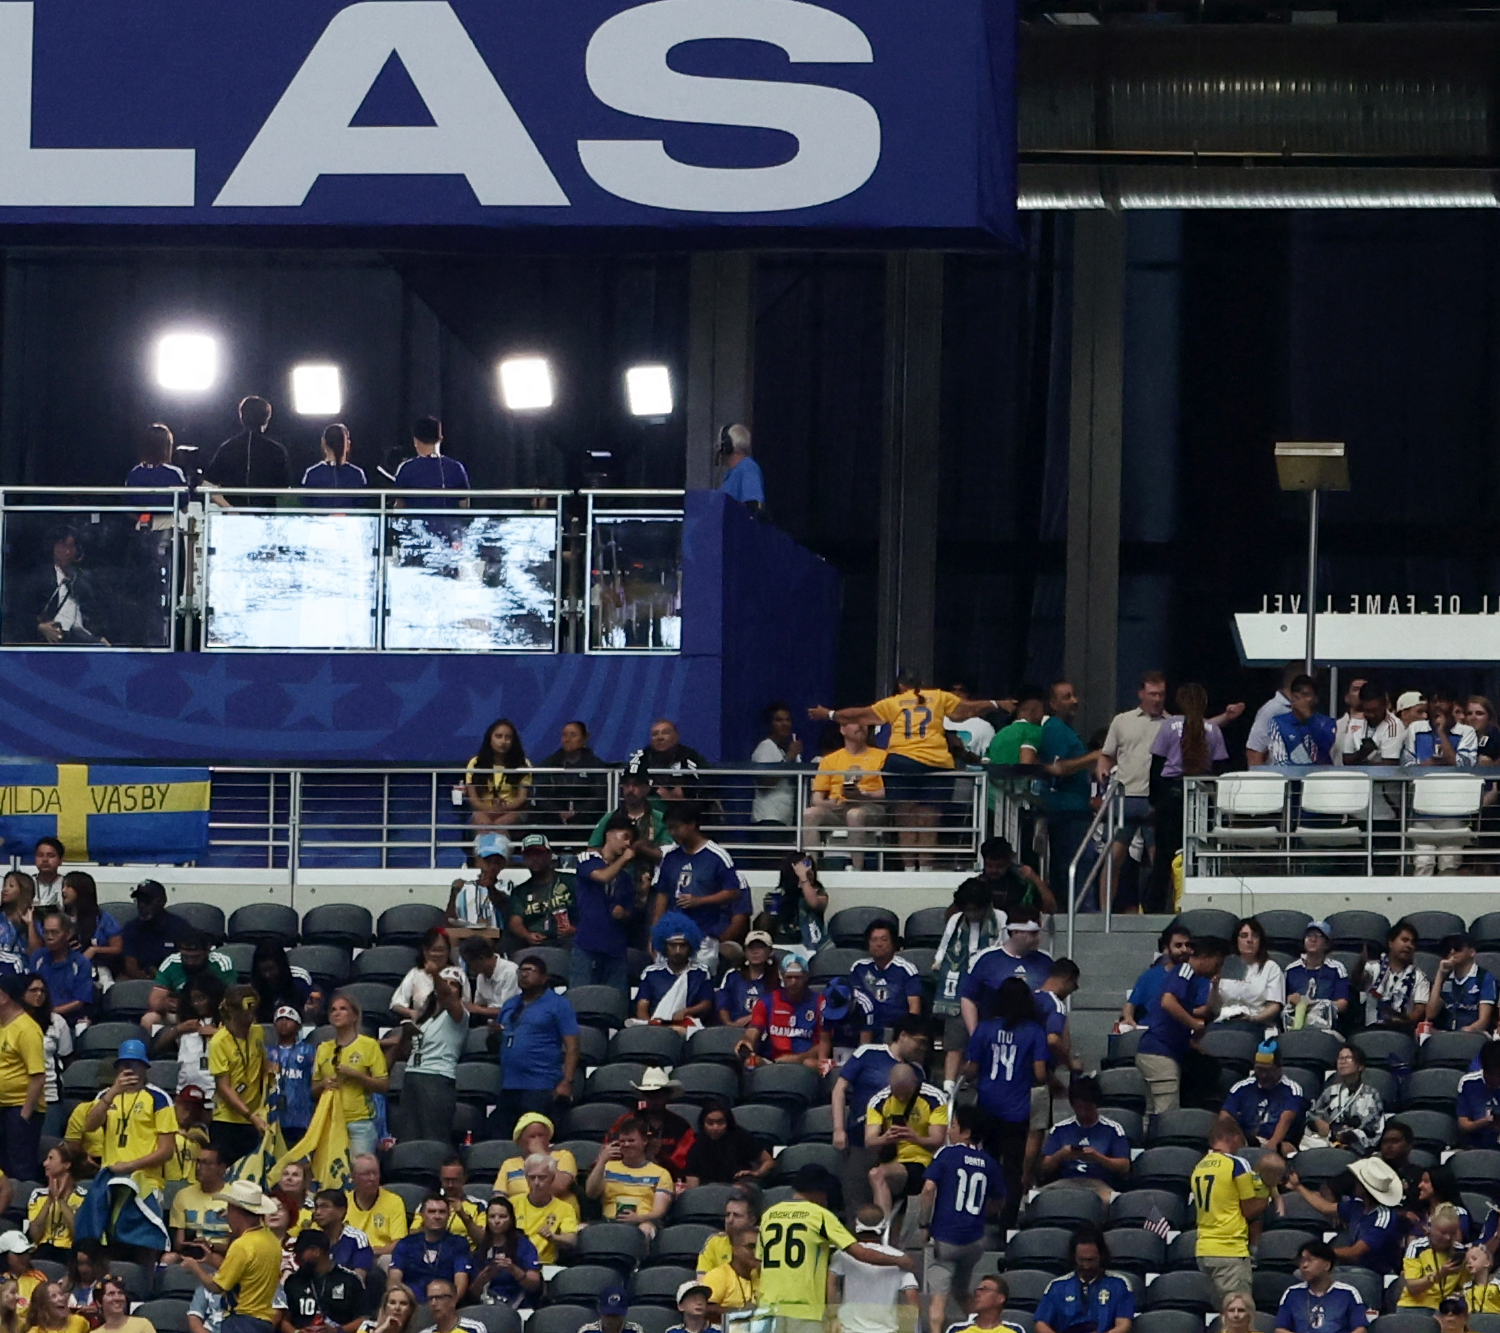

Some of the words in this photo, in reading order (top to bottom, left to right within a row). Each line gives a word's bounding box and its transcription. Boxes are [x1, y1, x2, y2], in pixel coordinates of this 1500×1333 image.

[902, 705, 933, 740] 17
[990, 1043, 1018, 1081] 14
[955, 1167, 988, 1215] 10
[1195, 1174, 1216, 1213] 17
[763, 1222, 808, 1269] 26
[299, 1297, 316, 1316] 10
